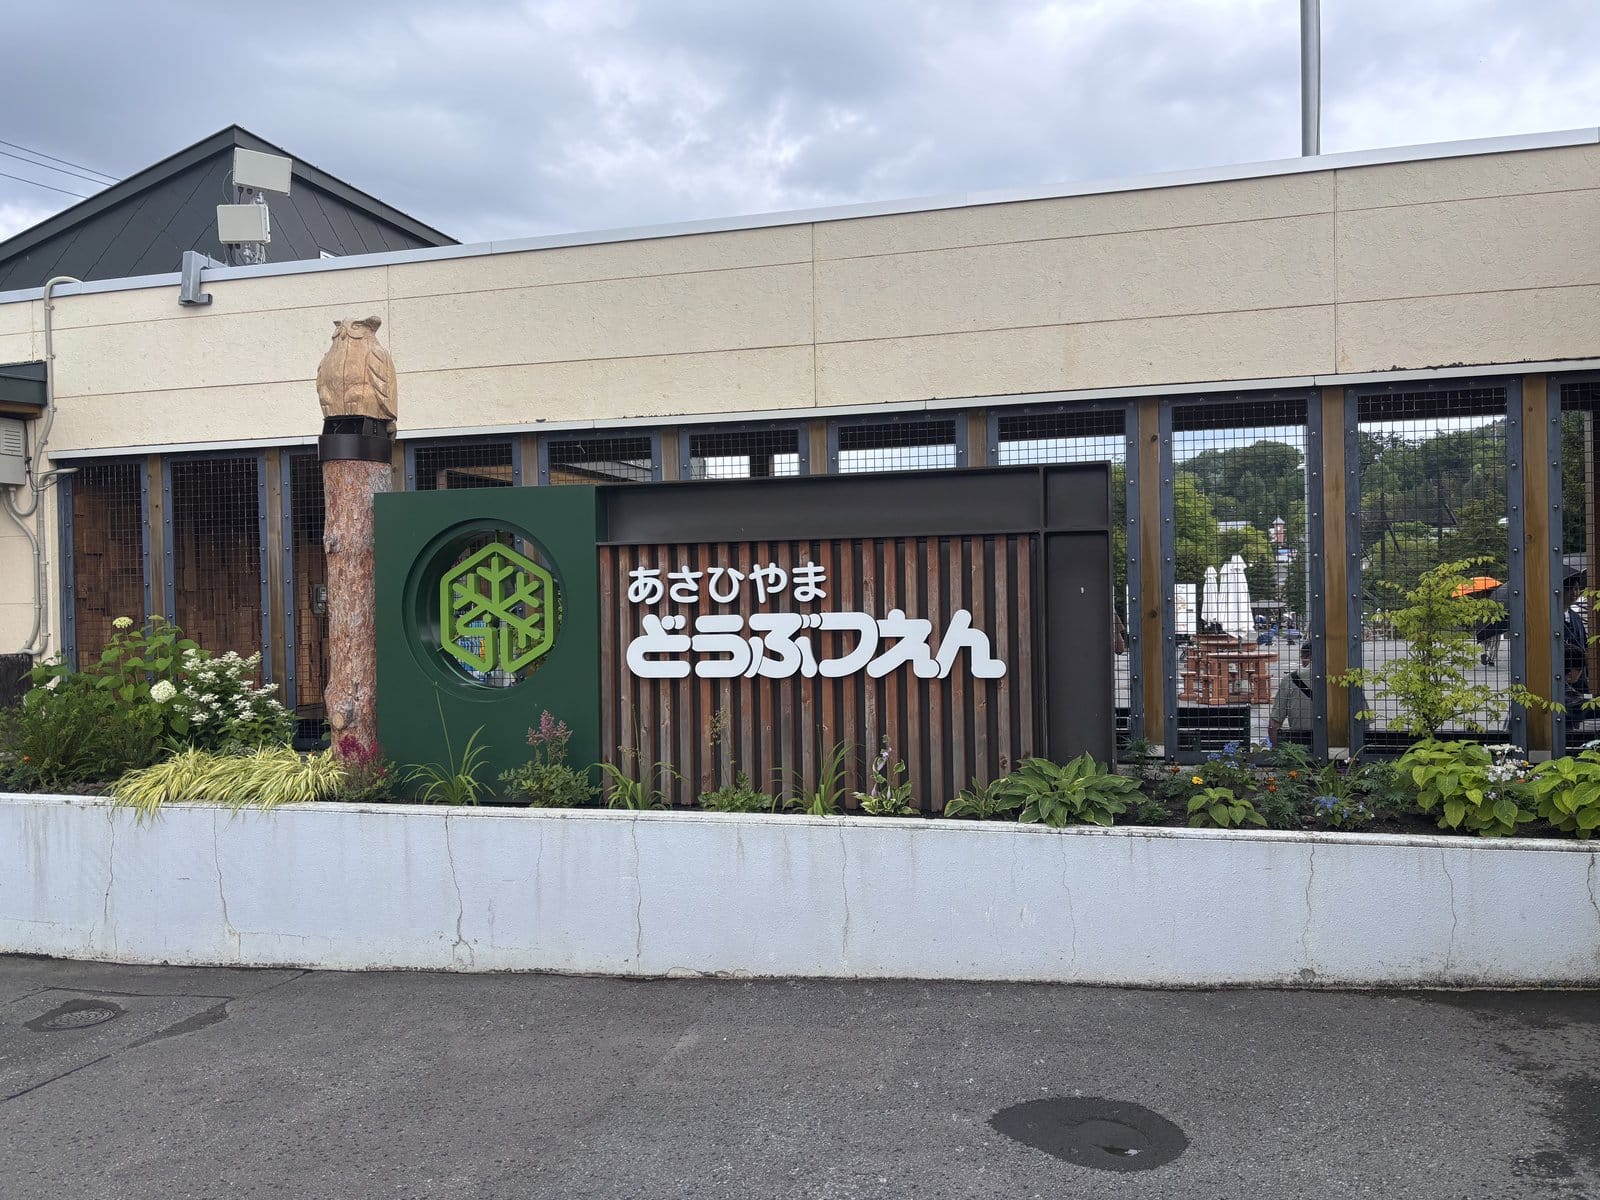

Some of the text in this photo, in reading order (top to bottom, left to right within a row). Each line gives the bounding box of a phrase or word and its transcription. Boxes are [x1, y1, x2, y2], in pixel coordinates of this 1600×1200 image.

[627, 562, 827, 604] あさひやま
[626, 609, 1007, 679] どうぶつえん
